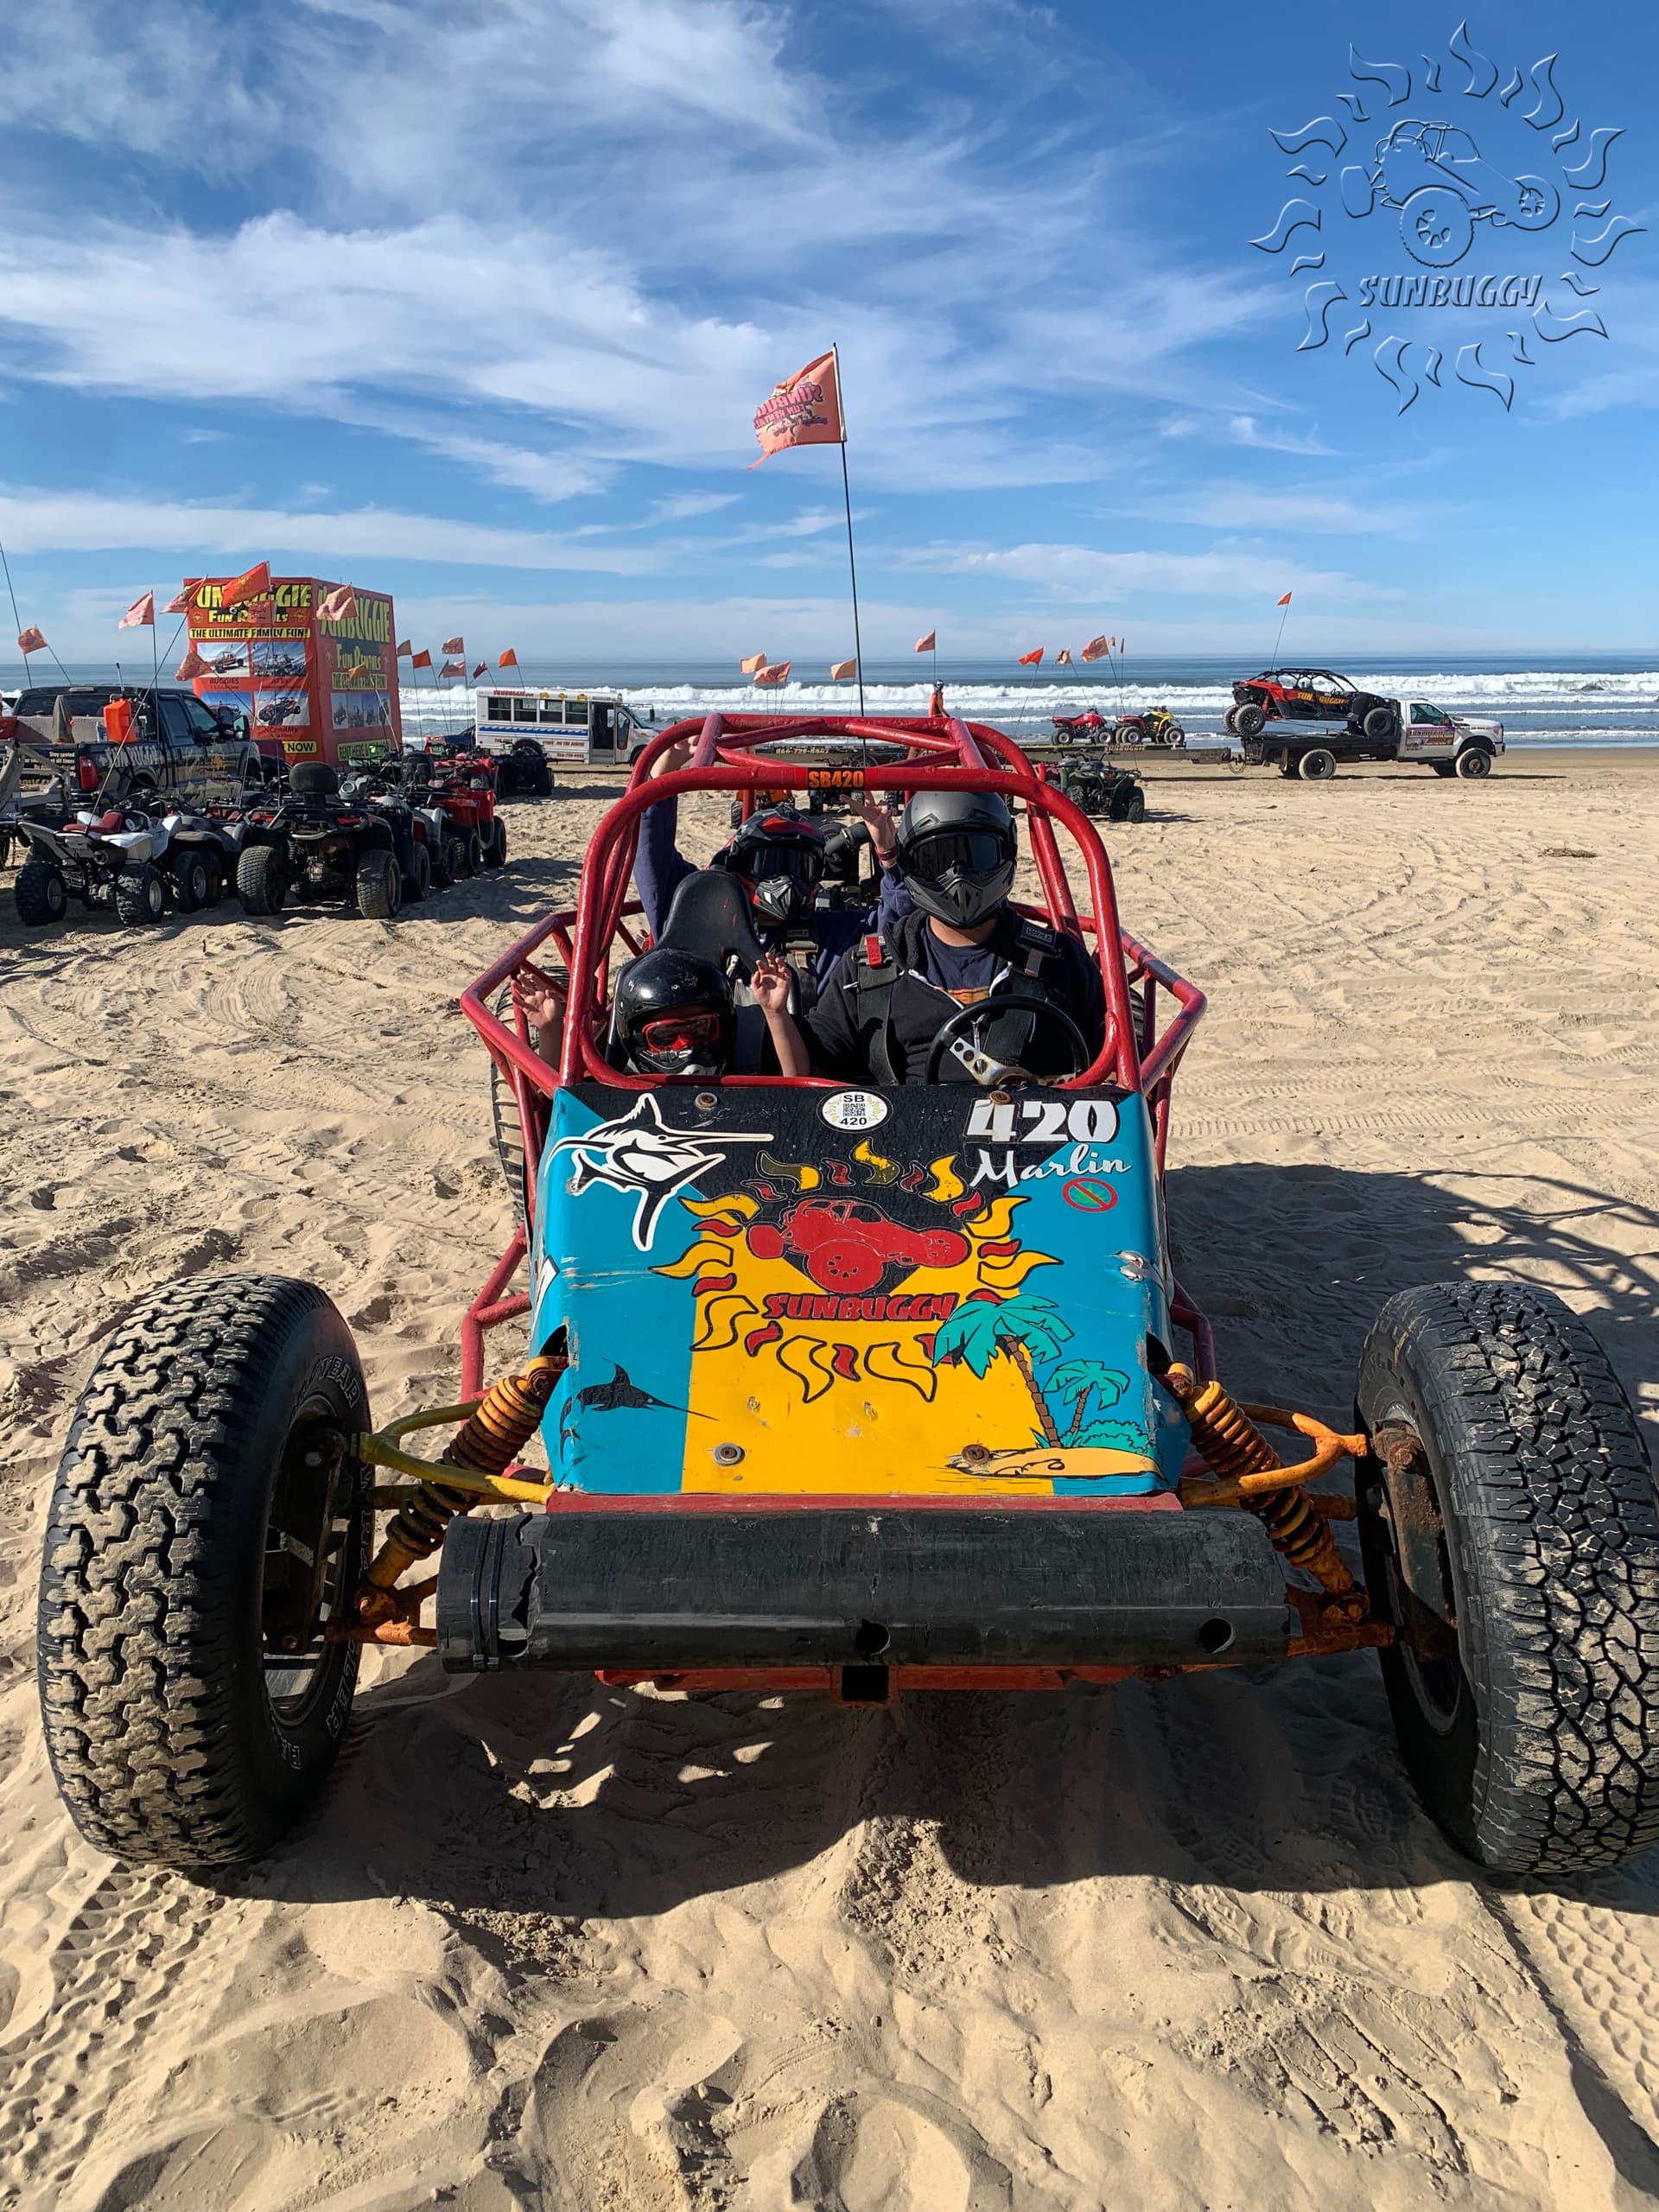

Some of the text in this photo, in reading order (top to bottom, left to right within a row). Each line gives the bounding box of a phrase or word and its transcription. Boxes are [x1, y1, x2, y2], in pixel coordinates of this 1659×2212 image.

[191, 629, 308, 638] THE ULTIMATE FAMILY FUN!
[1298, 691, 1313, 702] SUN
[288, 743, 314, 752] NOW
[809, 771, 864, 788] SB420
[840, 1117, 868, 1126] 420
[966, 1099, 1117, 1143] 420
[969, 1143, 1132, 1189] Marlin
[762, 1294, 960, 1321] SUNBUGGY
